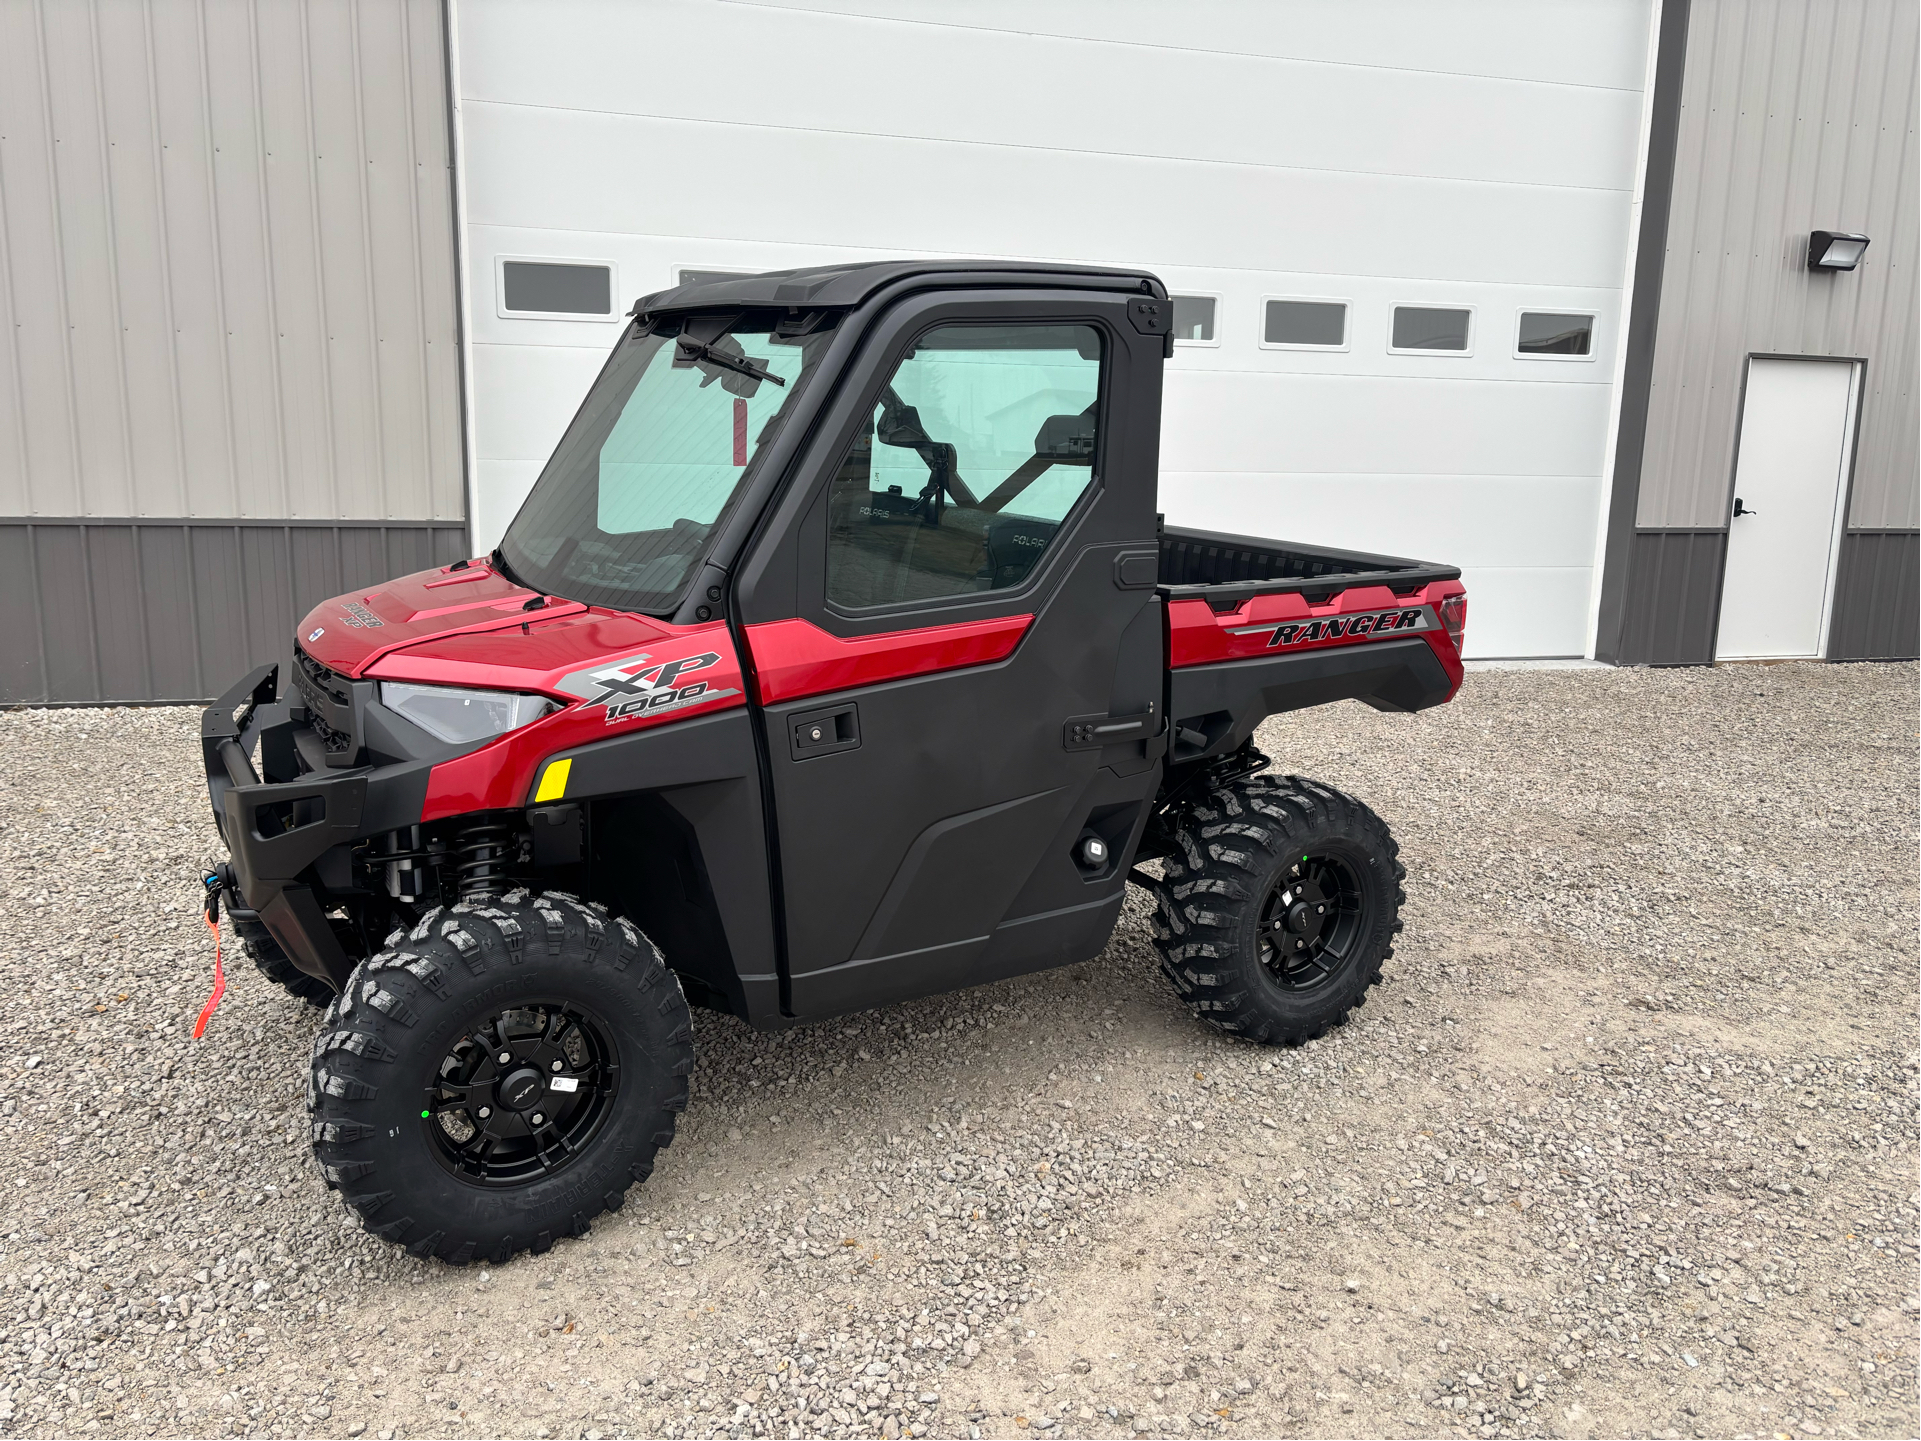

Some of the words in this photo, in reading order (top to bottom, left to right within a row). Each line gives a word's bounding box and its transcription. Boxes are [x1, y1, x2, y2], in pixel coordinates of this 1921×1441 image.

[859, 506, 890, 519] POLARIS
[338, 615, 363, 628] XP
[340, 602, 385, 628] RANGER
[1266, 608, 1423, 648] RANGER
[571, 651, 722, 713] XP
[604, 681, 709, 721] 1000
[605, 716, 630, 727] DUAL
[631, 702, 682, 719] OVERHEAD
[682, 696, 704, 708] CAM
[416, 1019, 449, 1057] PRO
[450, 978, 518, 1023] ARMOR
[513, 1083, 535, 1103] XP
[524, 1137, 635, 1225] X-TERRAIN
